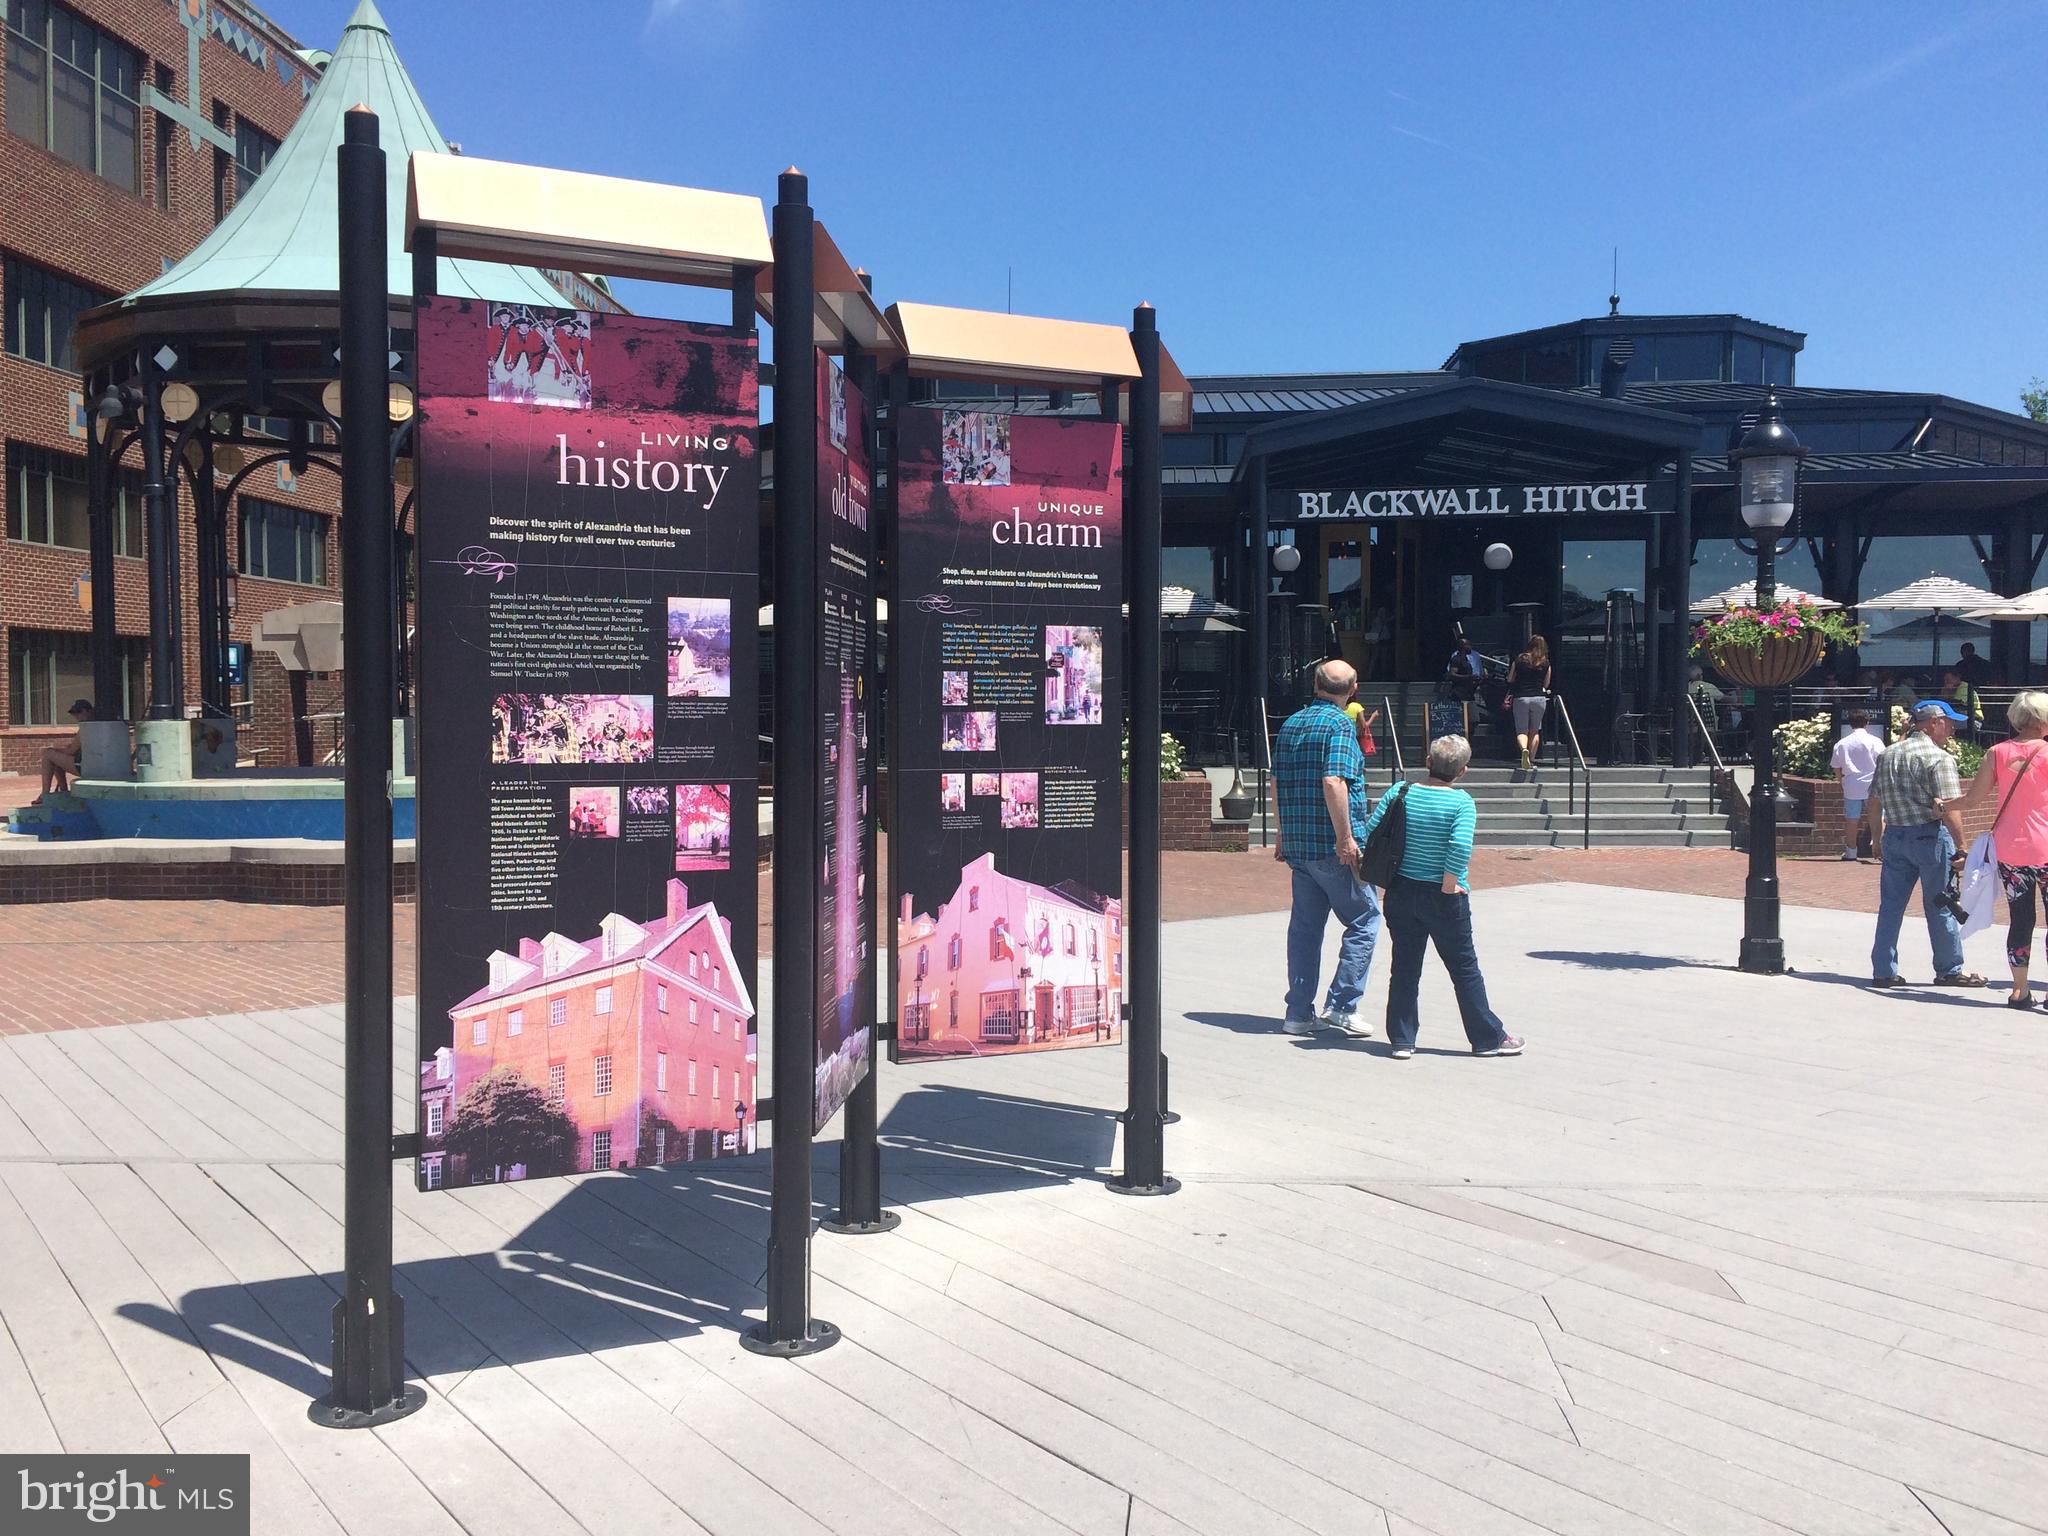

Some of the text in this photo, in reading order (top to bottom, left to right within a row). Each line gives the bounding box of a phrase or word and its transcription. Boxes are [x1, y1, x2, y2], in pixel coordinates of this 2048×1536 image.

[641, 432, 728, 450] LIVING
[556, 434, 728, 510] history
[832, 472, 866, 532] old town
[1038, 502, 1104, 516] UNIQUE
[1298, 484, 1647, 519] BLACKWALL HITCH
[489, 516, 690, 534] Discover the spirit of Alexandria that has been
[992, 507, 1103, 548] charm
[489, 531, 523, 541] making
[525, 533, 557, 542] history
[559, 533, 572, 542] for
[574, 535, 593, 543] well
[617, 537, 634, 545] two
[636, 539, 675, 547] centuries
[1026, 580, 1047, 591] always
[1062, 581, 1100, 593] revolutionary
